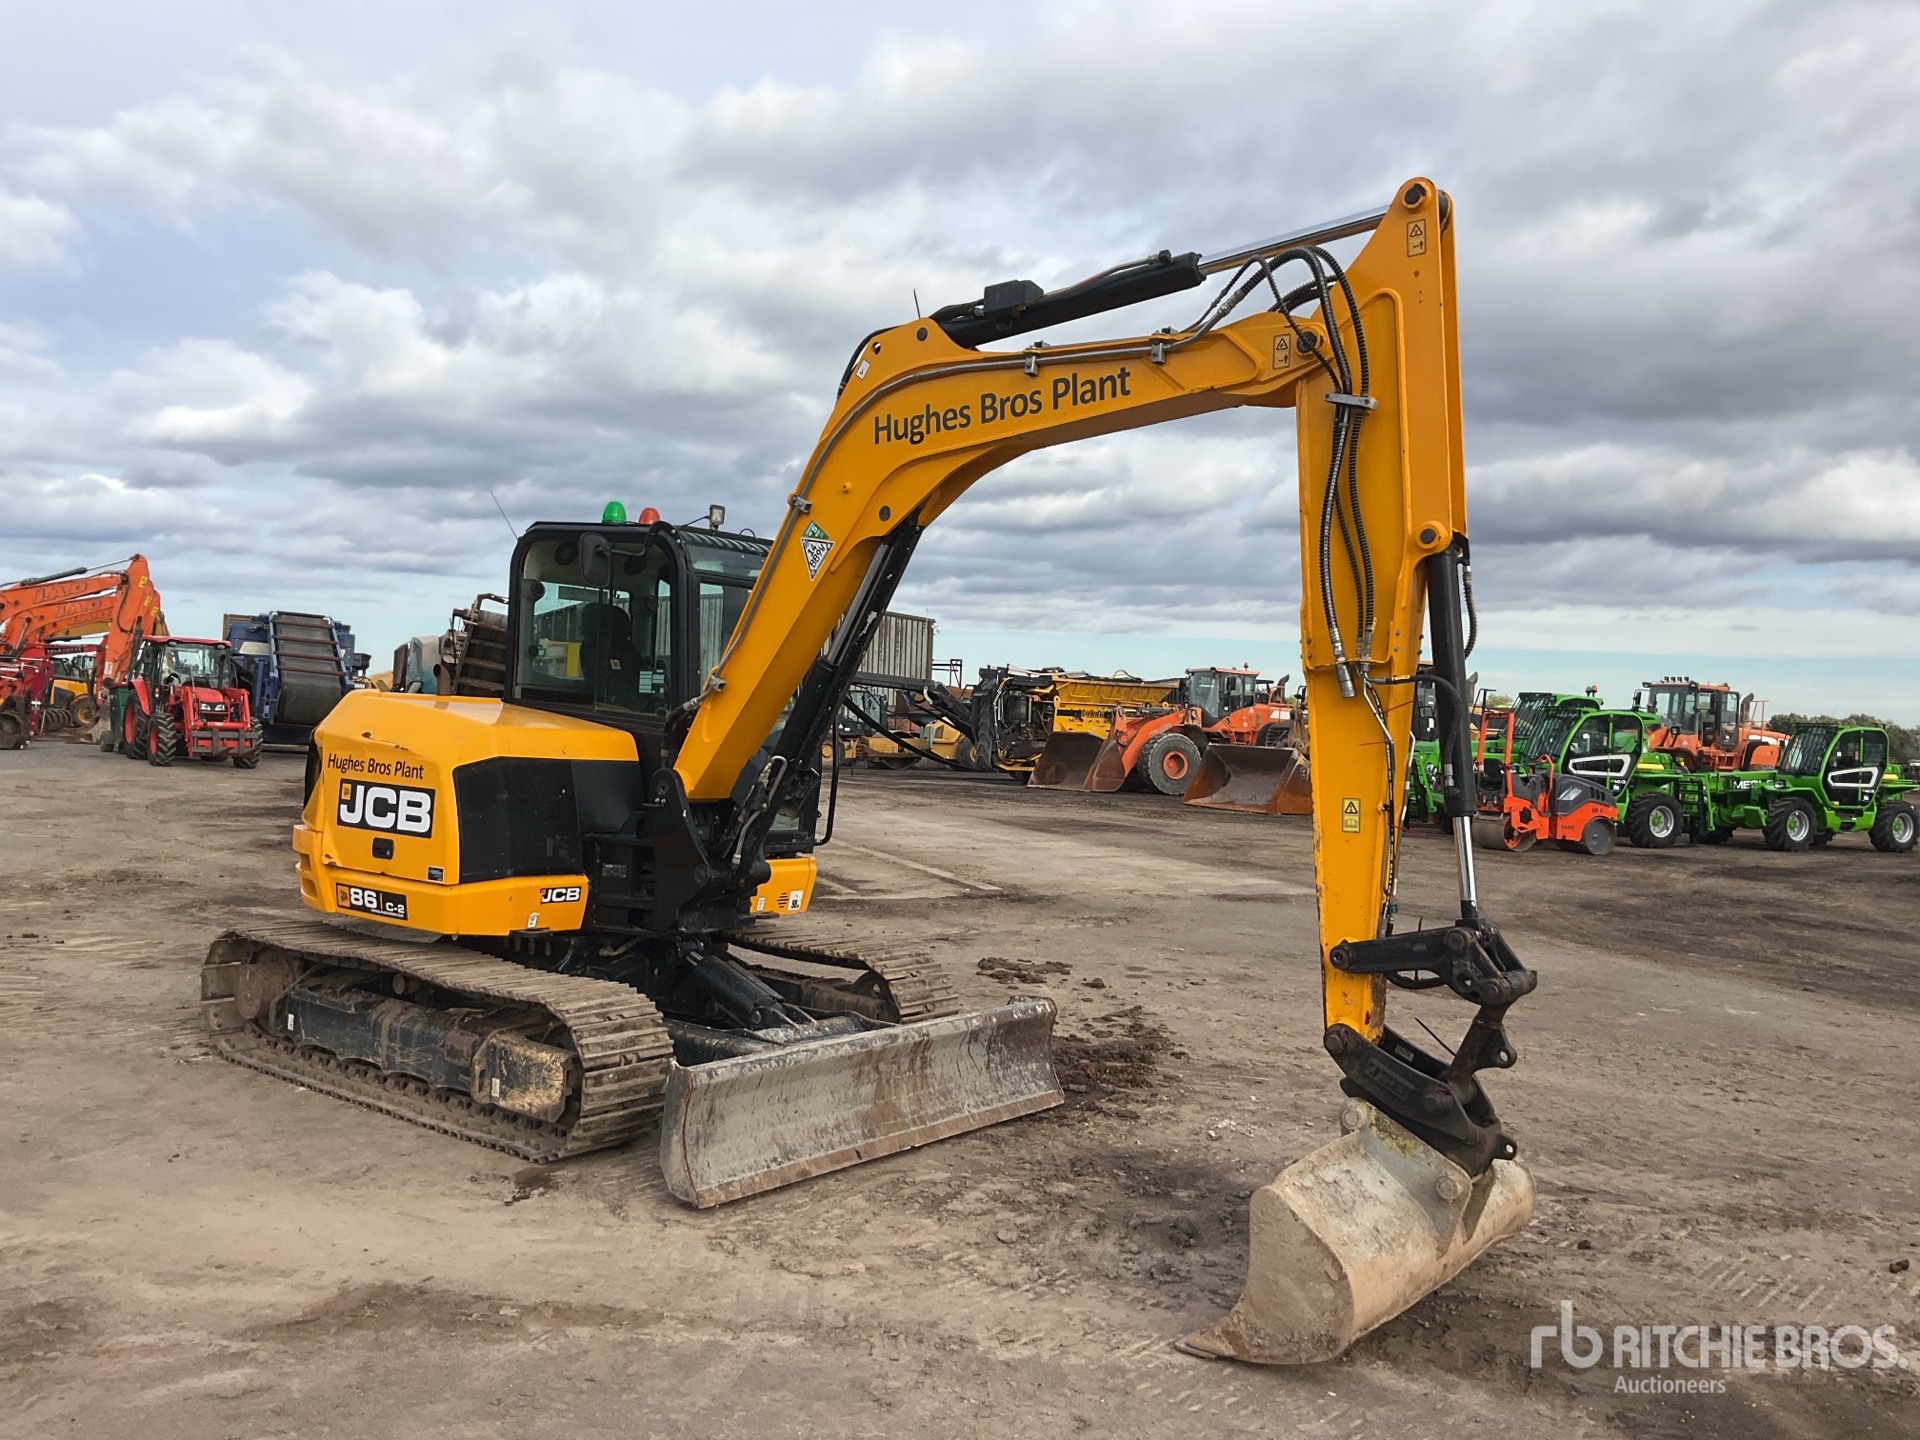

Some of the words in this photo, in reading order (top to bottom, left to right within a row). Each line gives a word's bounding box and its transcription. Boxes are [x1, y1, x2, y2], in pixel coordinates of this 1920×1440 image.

[874, 404, 971, 445] Hughes
[980, 390, 1043, 424] Bros
[1052, 367, 1131, 410] Plant
[328, 753, 365, 774] Hughes
[367, 758, 392, 776] Bros
[394, 761, 425, 780] Plant
[340, 784, 432, 834] JCB
[350, 887, 378, 909] 86
[541, 887, 581, 903] JCB
